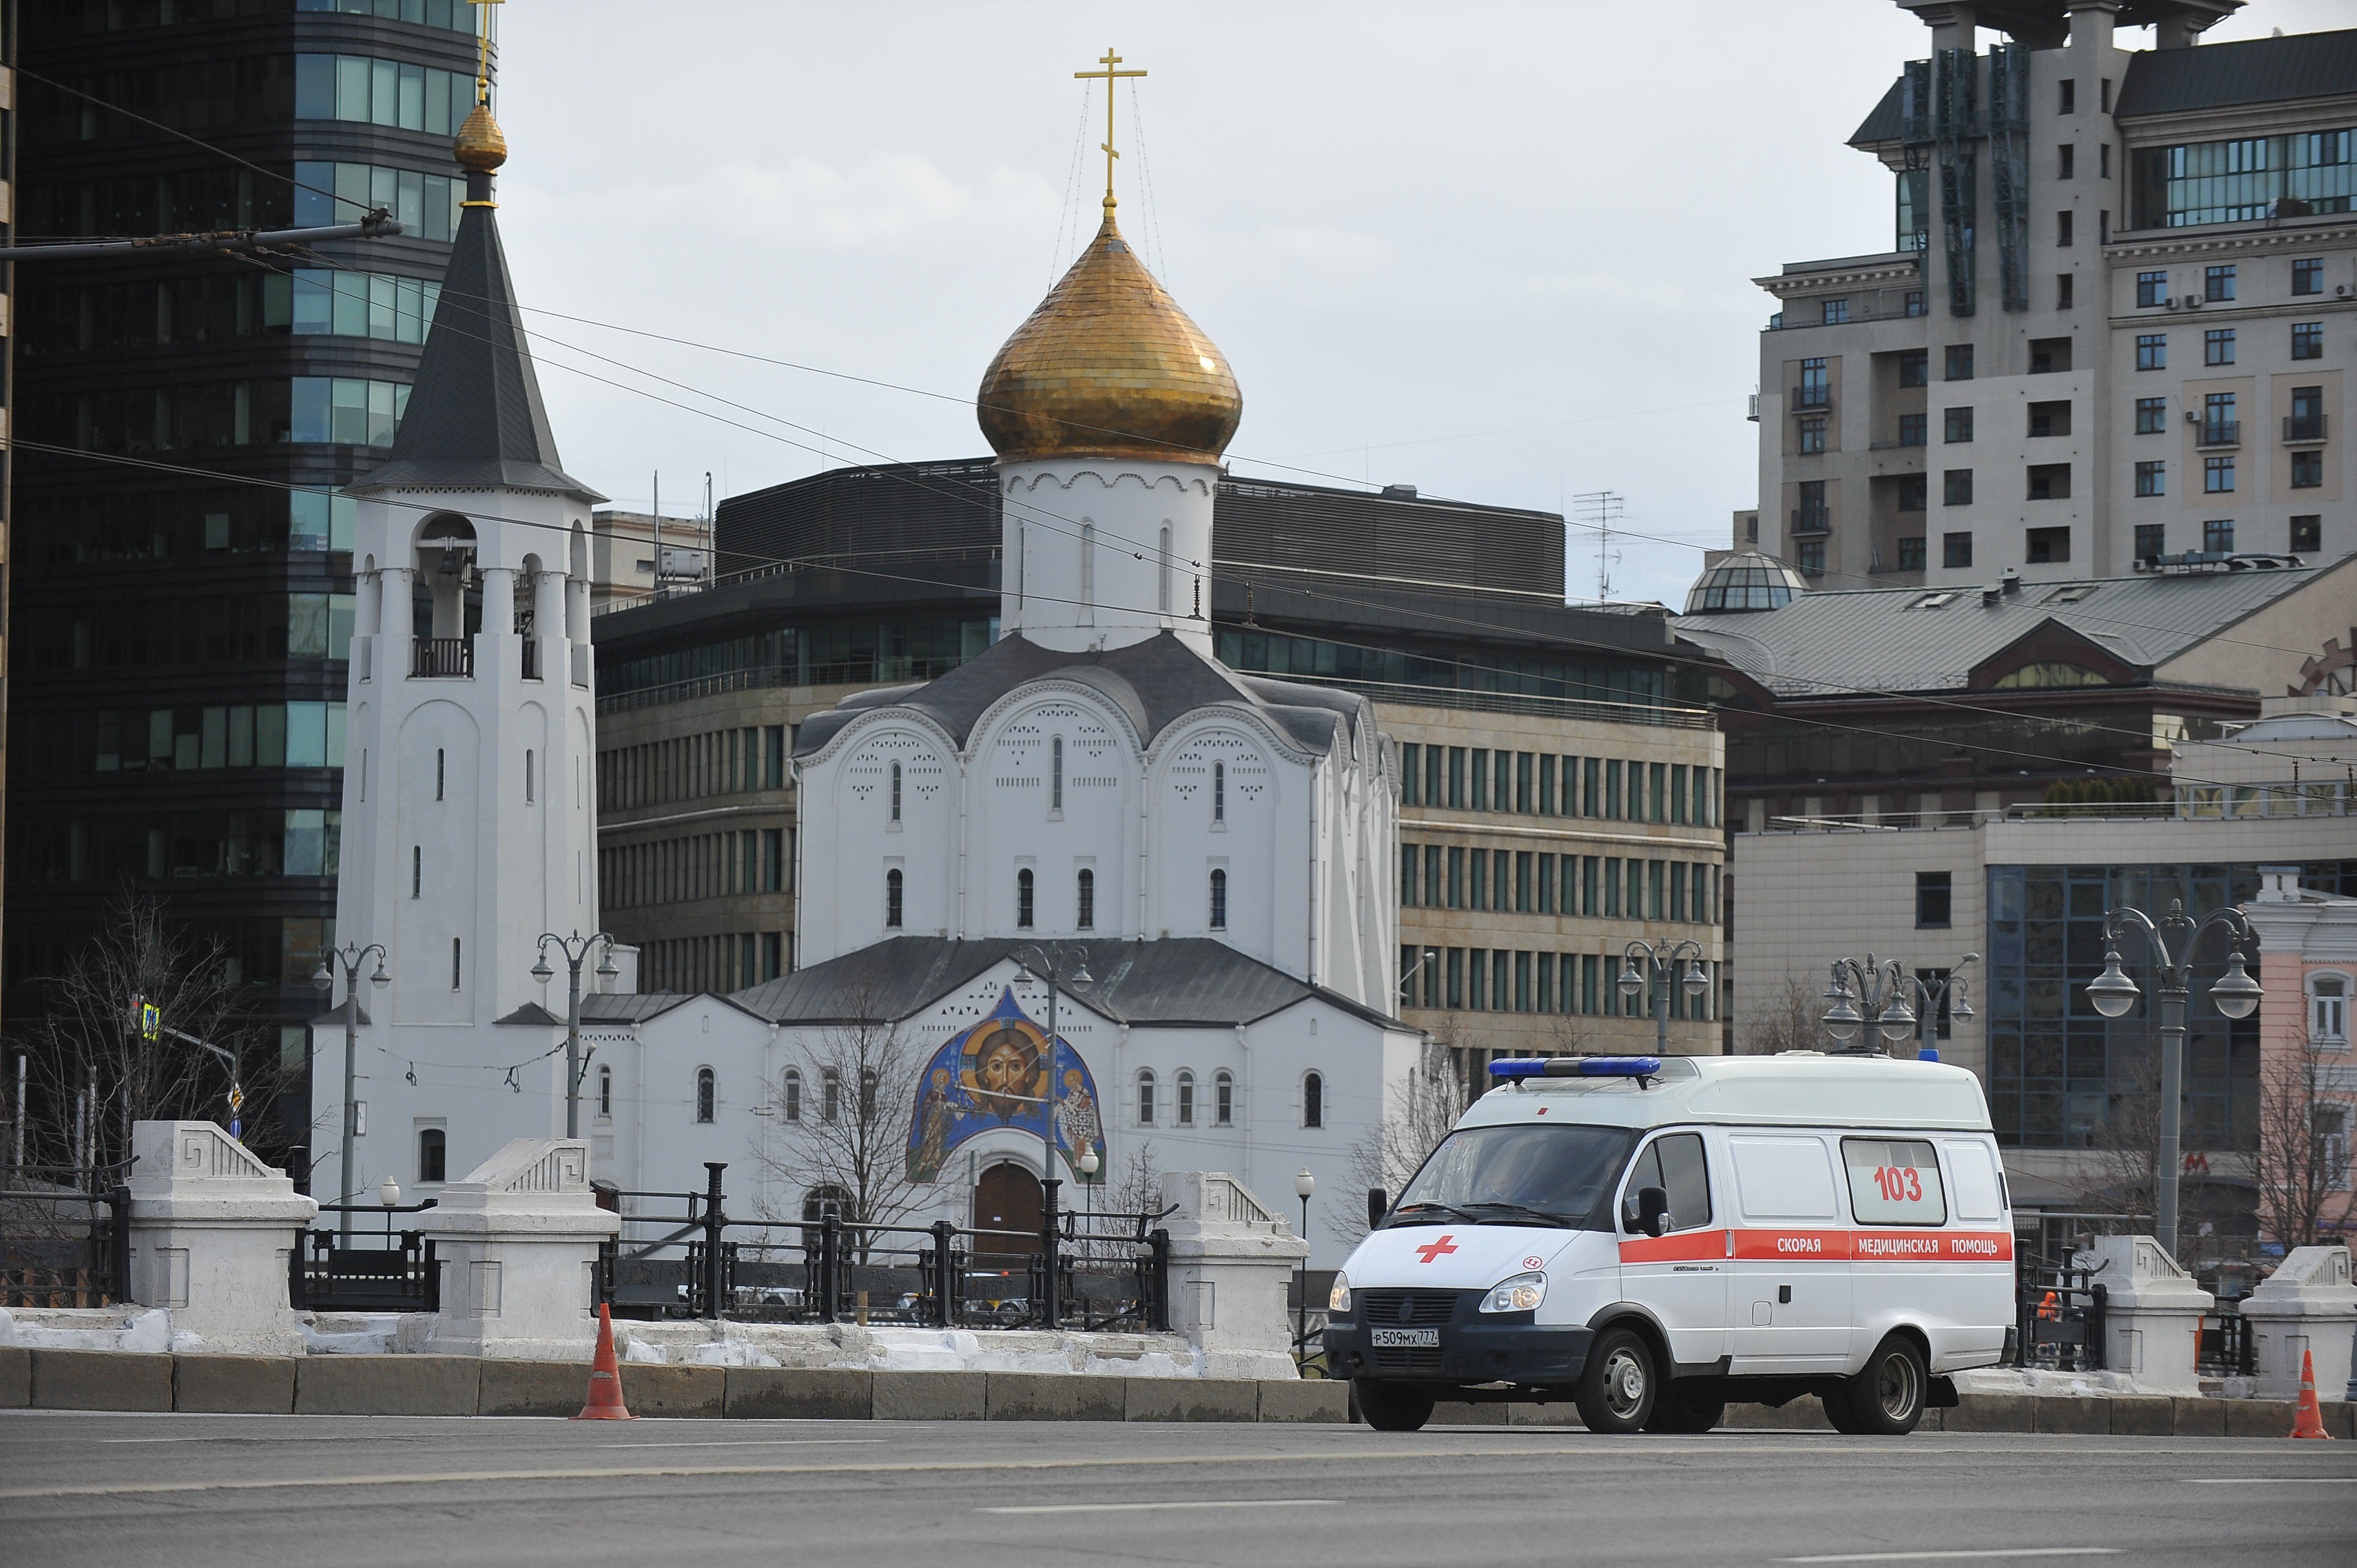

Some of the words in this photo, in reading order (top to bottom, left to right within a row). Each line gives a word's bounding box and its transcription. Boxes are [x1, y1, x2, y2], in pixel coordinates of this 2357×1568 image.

[1874, 1167, 1922, 1201] 103
[1777, 1237, 1821, 1252] СКОРАЯ
[1859, 1239, 1938, 1256] МЕДИЦИНСКАЯ
[1952, 1239, 1997, 1256] ПОМОЩЬ
[1418, 1330, 1435, 1341] 777
